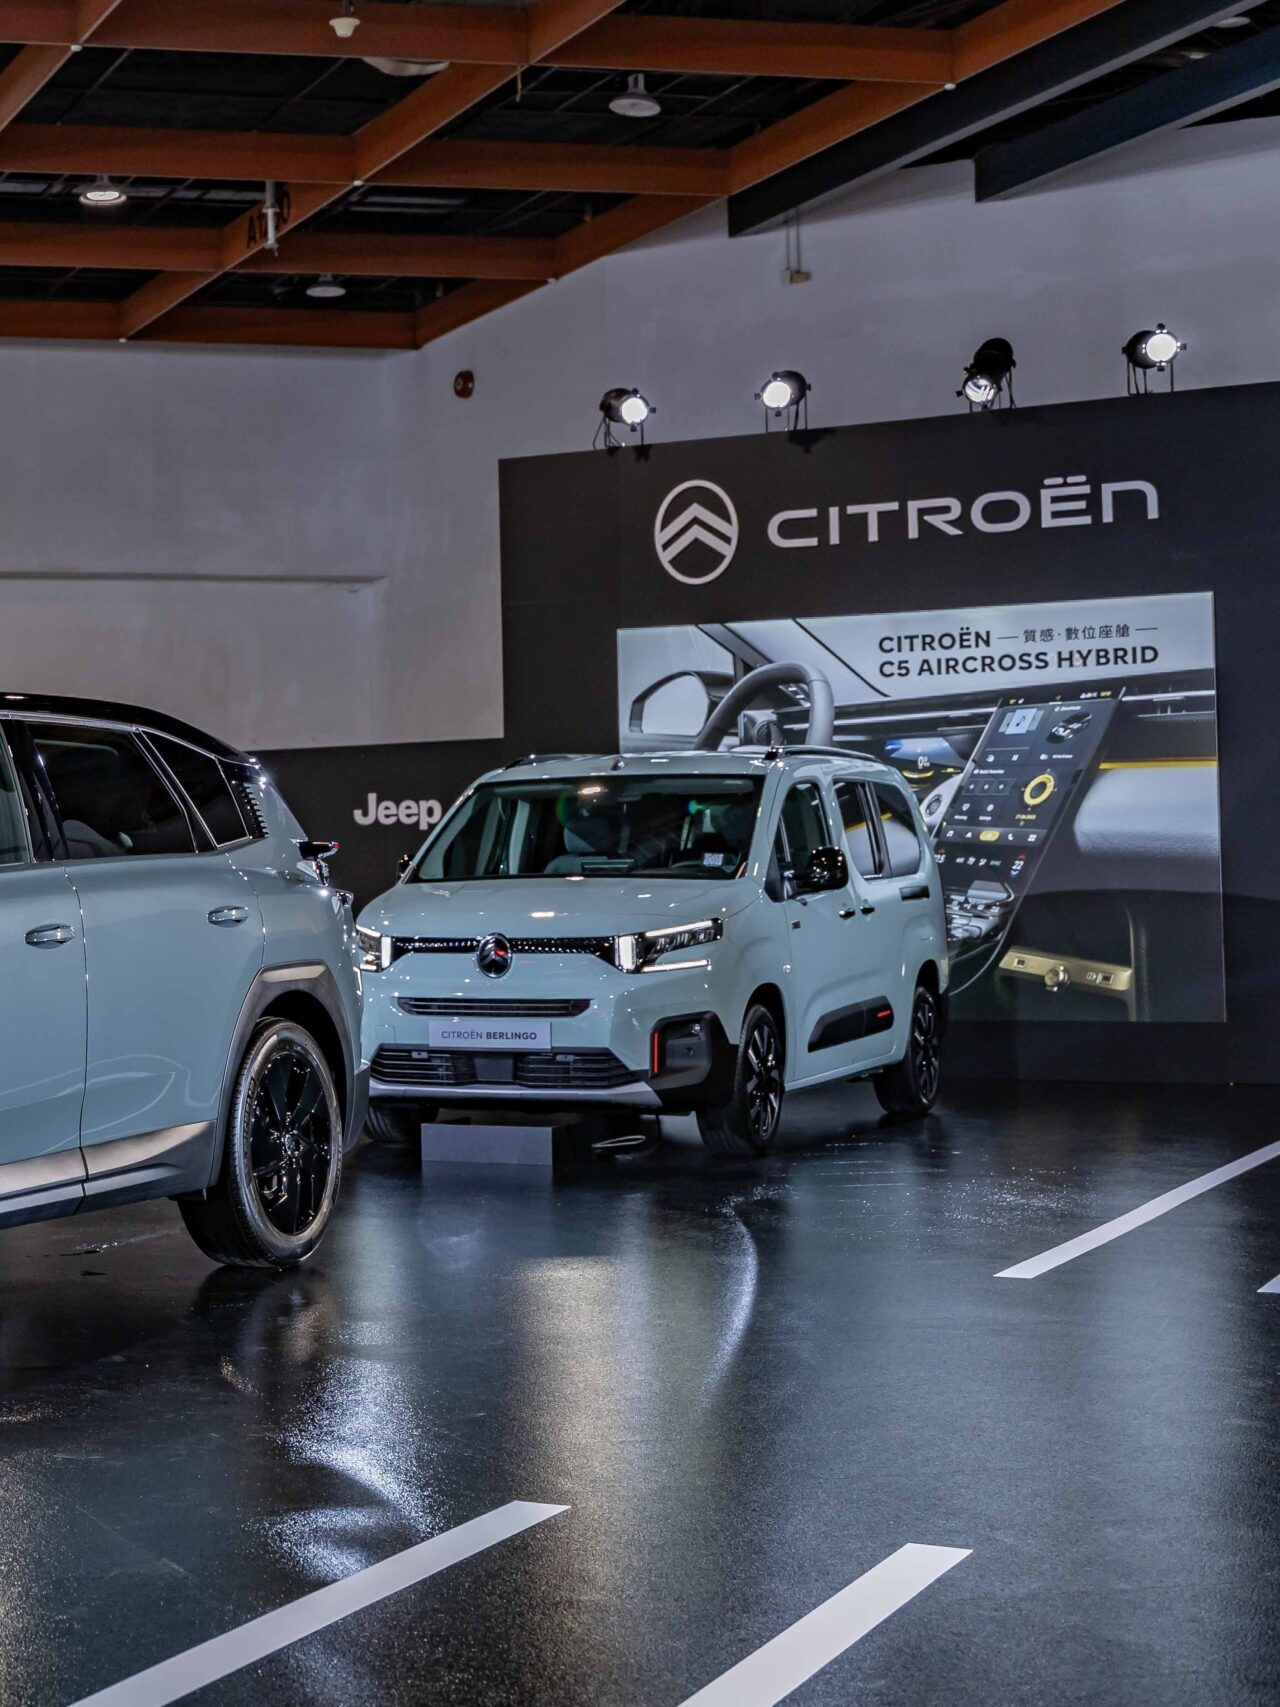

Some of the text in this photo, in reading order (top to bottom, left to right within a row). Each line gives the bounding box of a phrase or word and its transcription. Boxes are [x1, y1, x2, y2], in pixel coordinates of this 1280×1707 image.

[767, 475, 1159, 548] CITROËN
[879, 626, 991, 654] CITROËN
[879, 645, 1159, 678] C5 AIRCROSS HYBRID
[353, 792, 442, 831] Jeep
[441, 1029, 537, 1040] CITROËN BERLINGO
